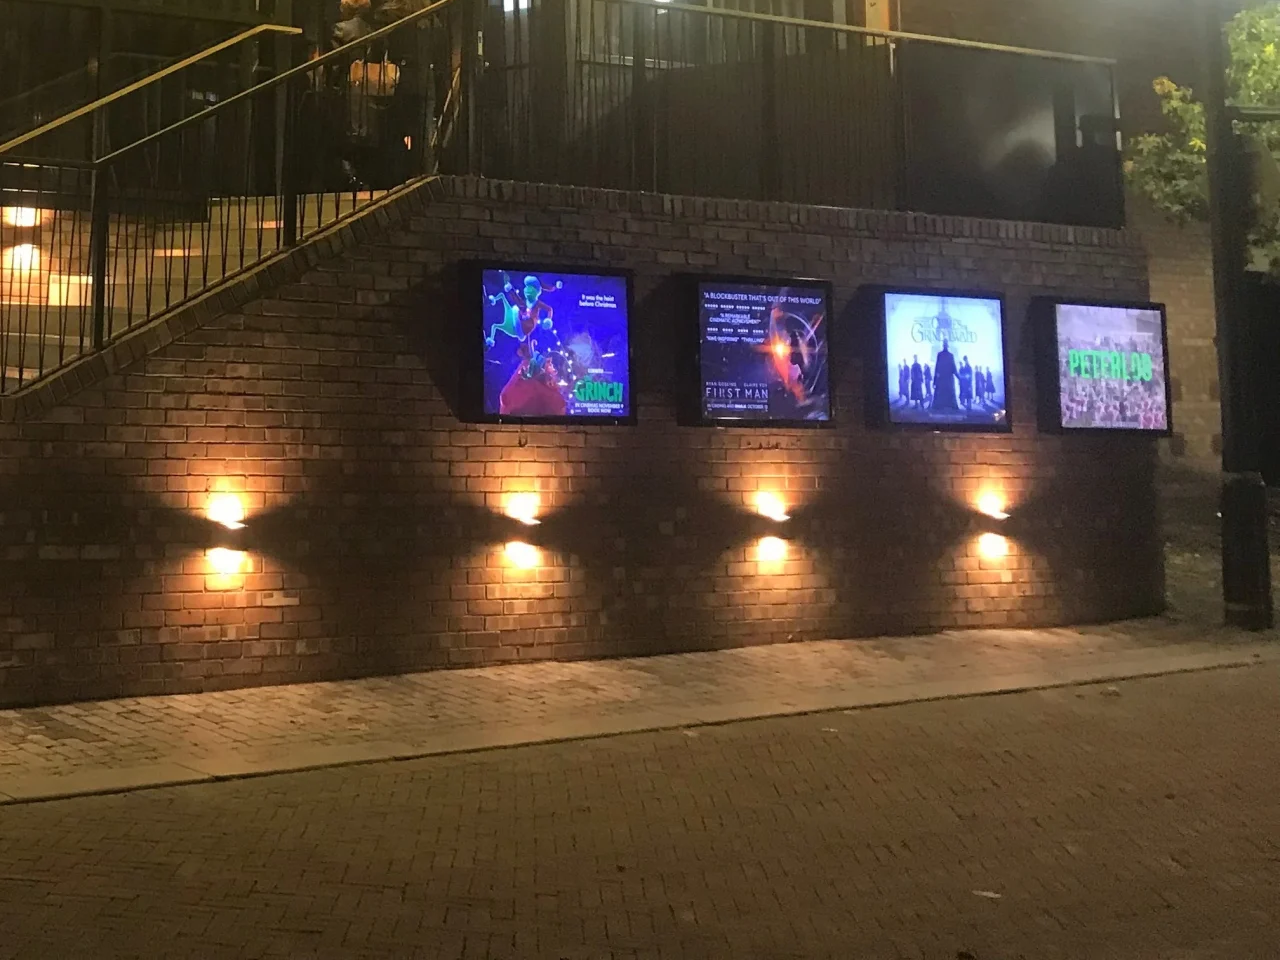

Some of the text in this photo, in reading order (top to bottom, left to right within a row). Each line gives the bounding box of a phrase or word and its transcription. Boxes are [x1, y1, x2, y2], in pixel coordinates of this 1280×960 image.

[710, 292, 748, 301] BLOCKBUSTER
[748, 294, 767, 302] THAT'S
[779, 295, 787, 303] OF
[787, 296, 800, 304] THIS
[1068, 348, 1153, 381] PETERLOO
[574, 380, 624, 402] GRINCH
[705, 387, 769, 399] FIRST MAN
